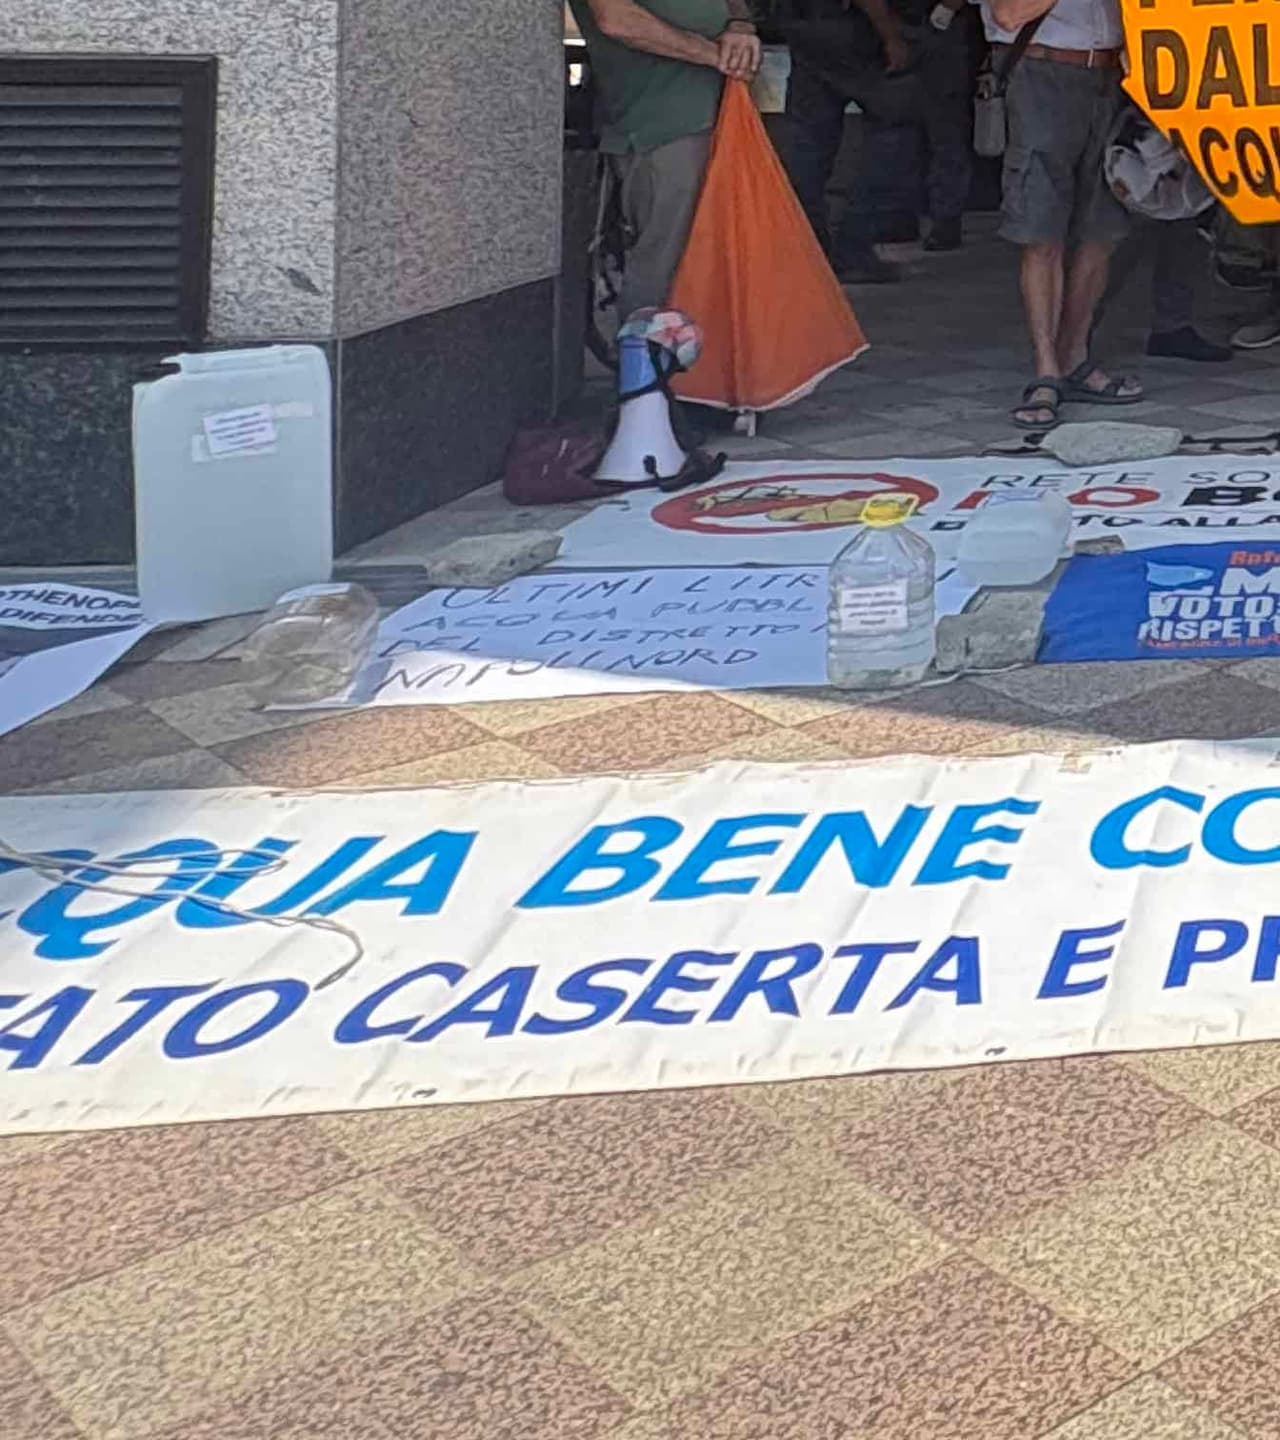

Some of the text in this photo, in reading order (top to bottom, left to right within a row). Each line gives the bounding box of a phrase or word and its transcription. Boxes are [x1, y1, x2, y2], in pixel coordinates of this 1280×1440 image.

[980, 471, 1155, 488] RETE
[442, 573, 820, 609] ULTIMI LITR
[1149, 594, 1275, 620] VOTO
[402, 607, 617, 632] ACQUA
[378, 637, 481, 658] DEL
[536, 624, 802, 646] DISTRETTO
[371, 648, 758, 696] NAPOLI NORD
[517, 800, 1041, 909] BENE
[0, 978, 310, 1070] ATO
[333, 934, 982, 1044] CASERTA
[1037, 919, 1125, 1000] E
